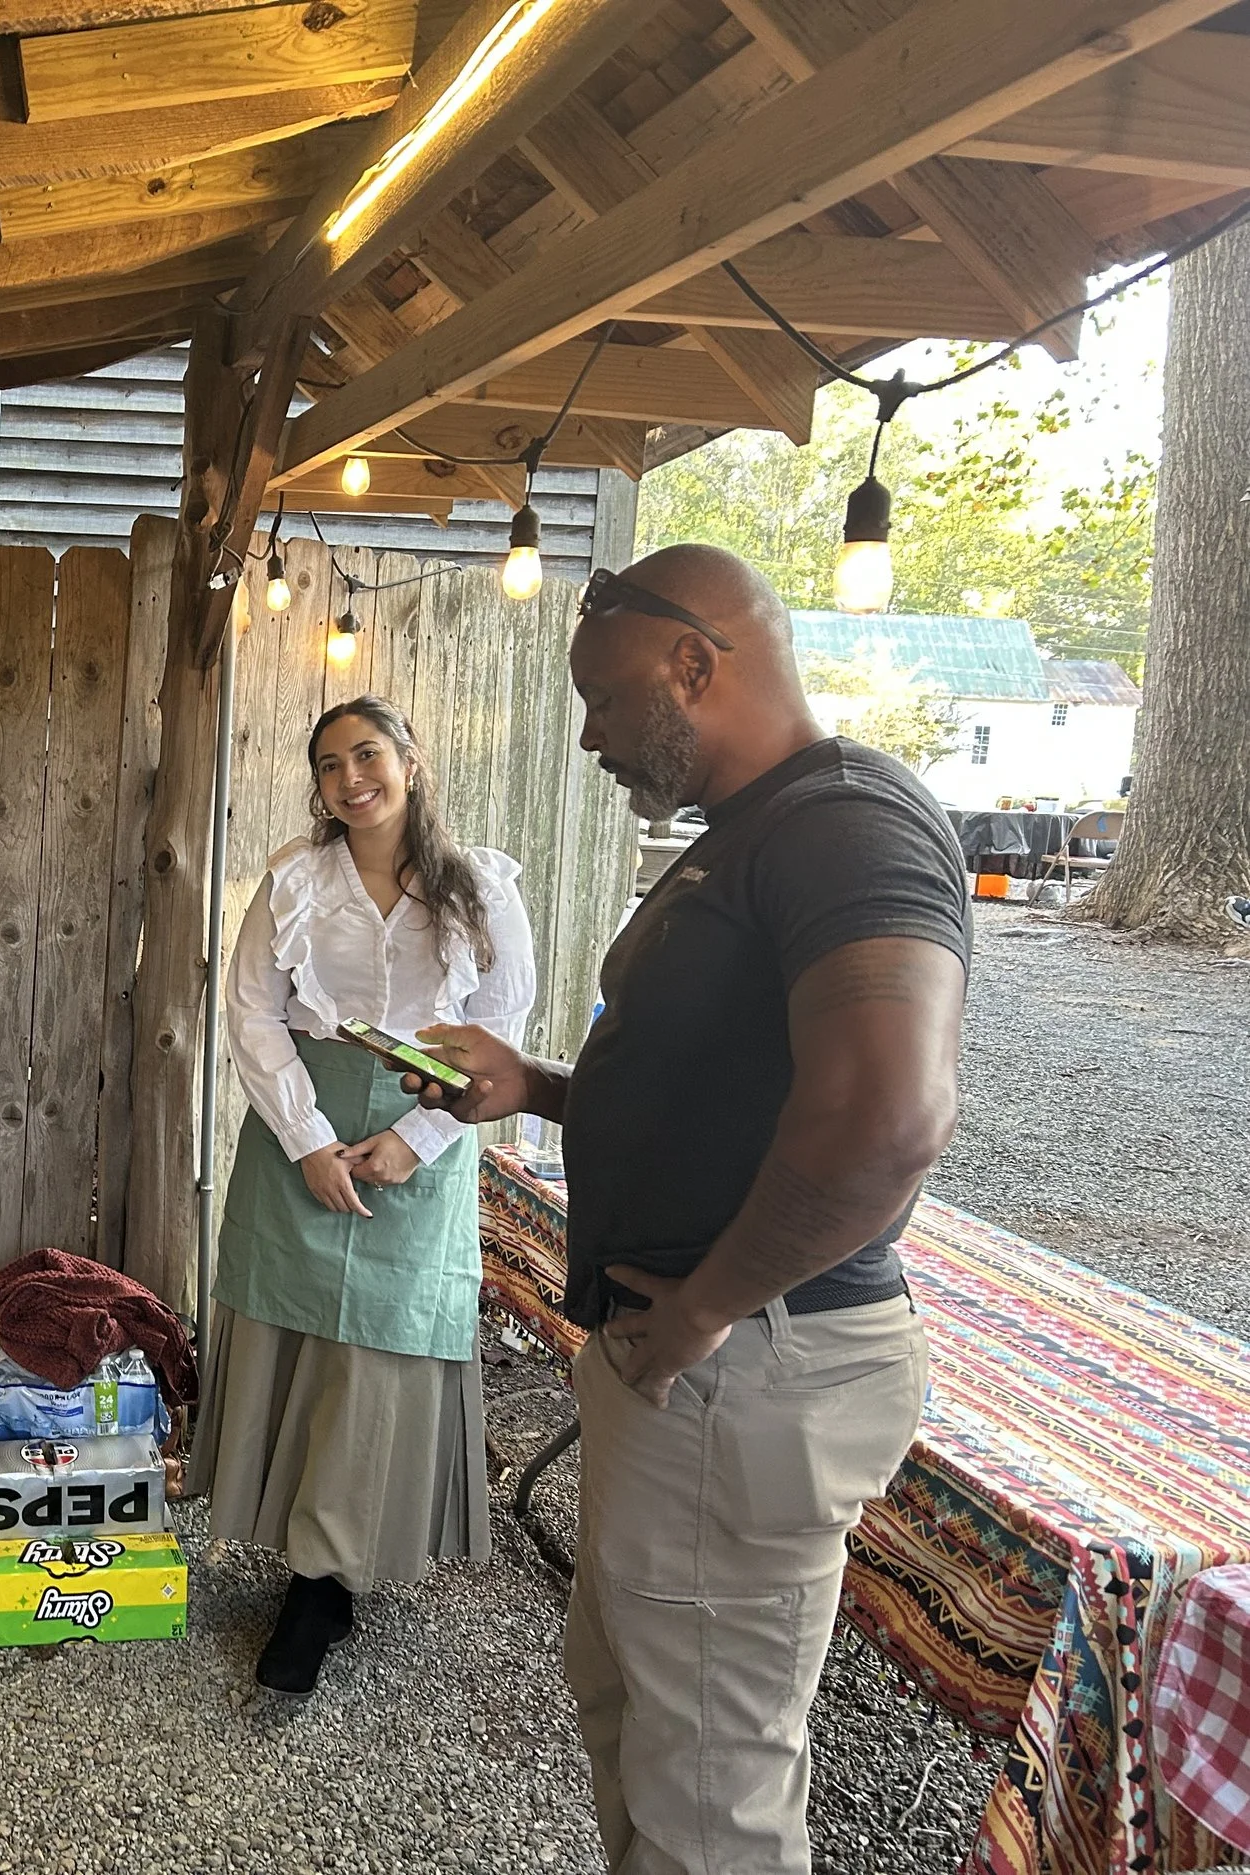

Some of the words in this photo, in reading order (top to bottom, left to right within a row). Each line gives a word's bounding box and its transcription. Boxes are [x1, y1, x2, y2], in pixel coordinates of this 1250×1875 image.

[99, 1395, 114, 1404] 24
[35, 1587, 112, 1628] Starry
[171, 1628, 184, 1637] 12
